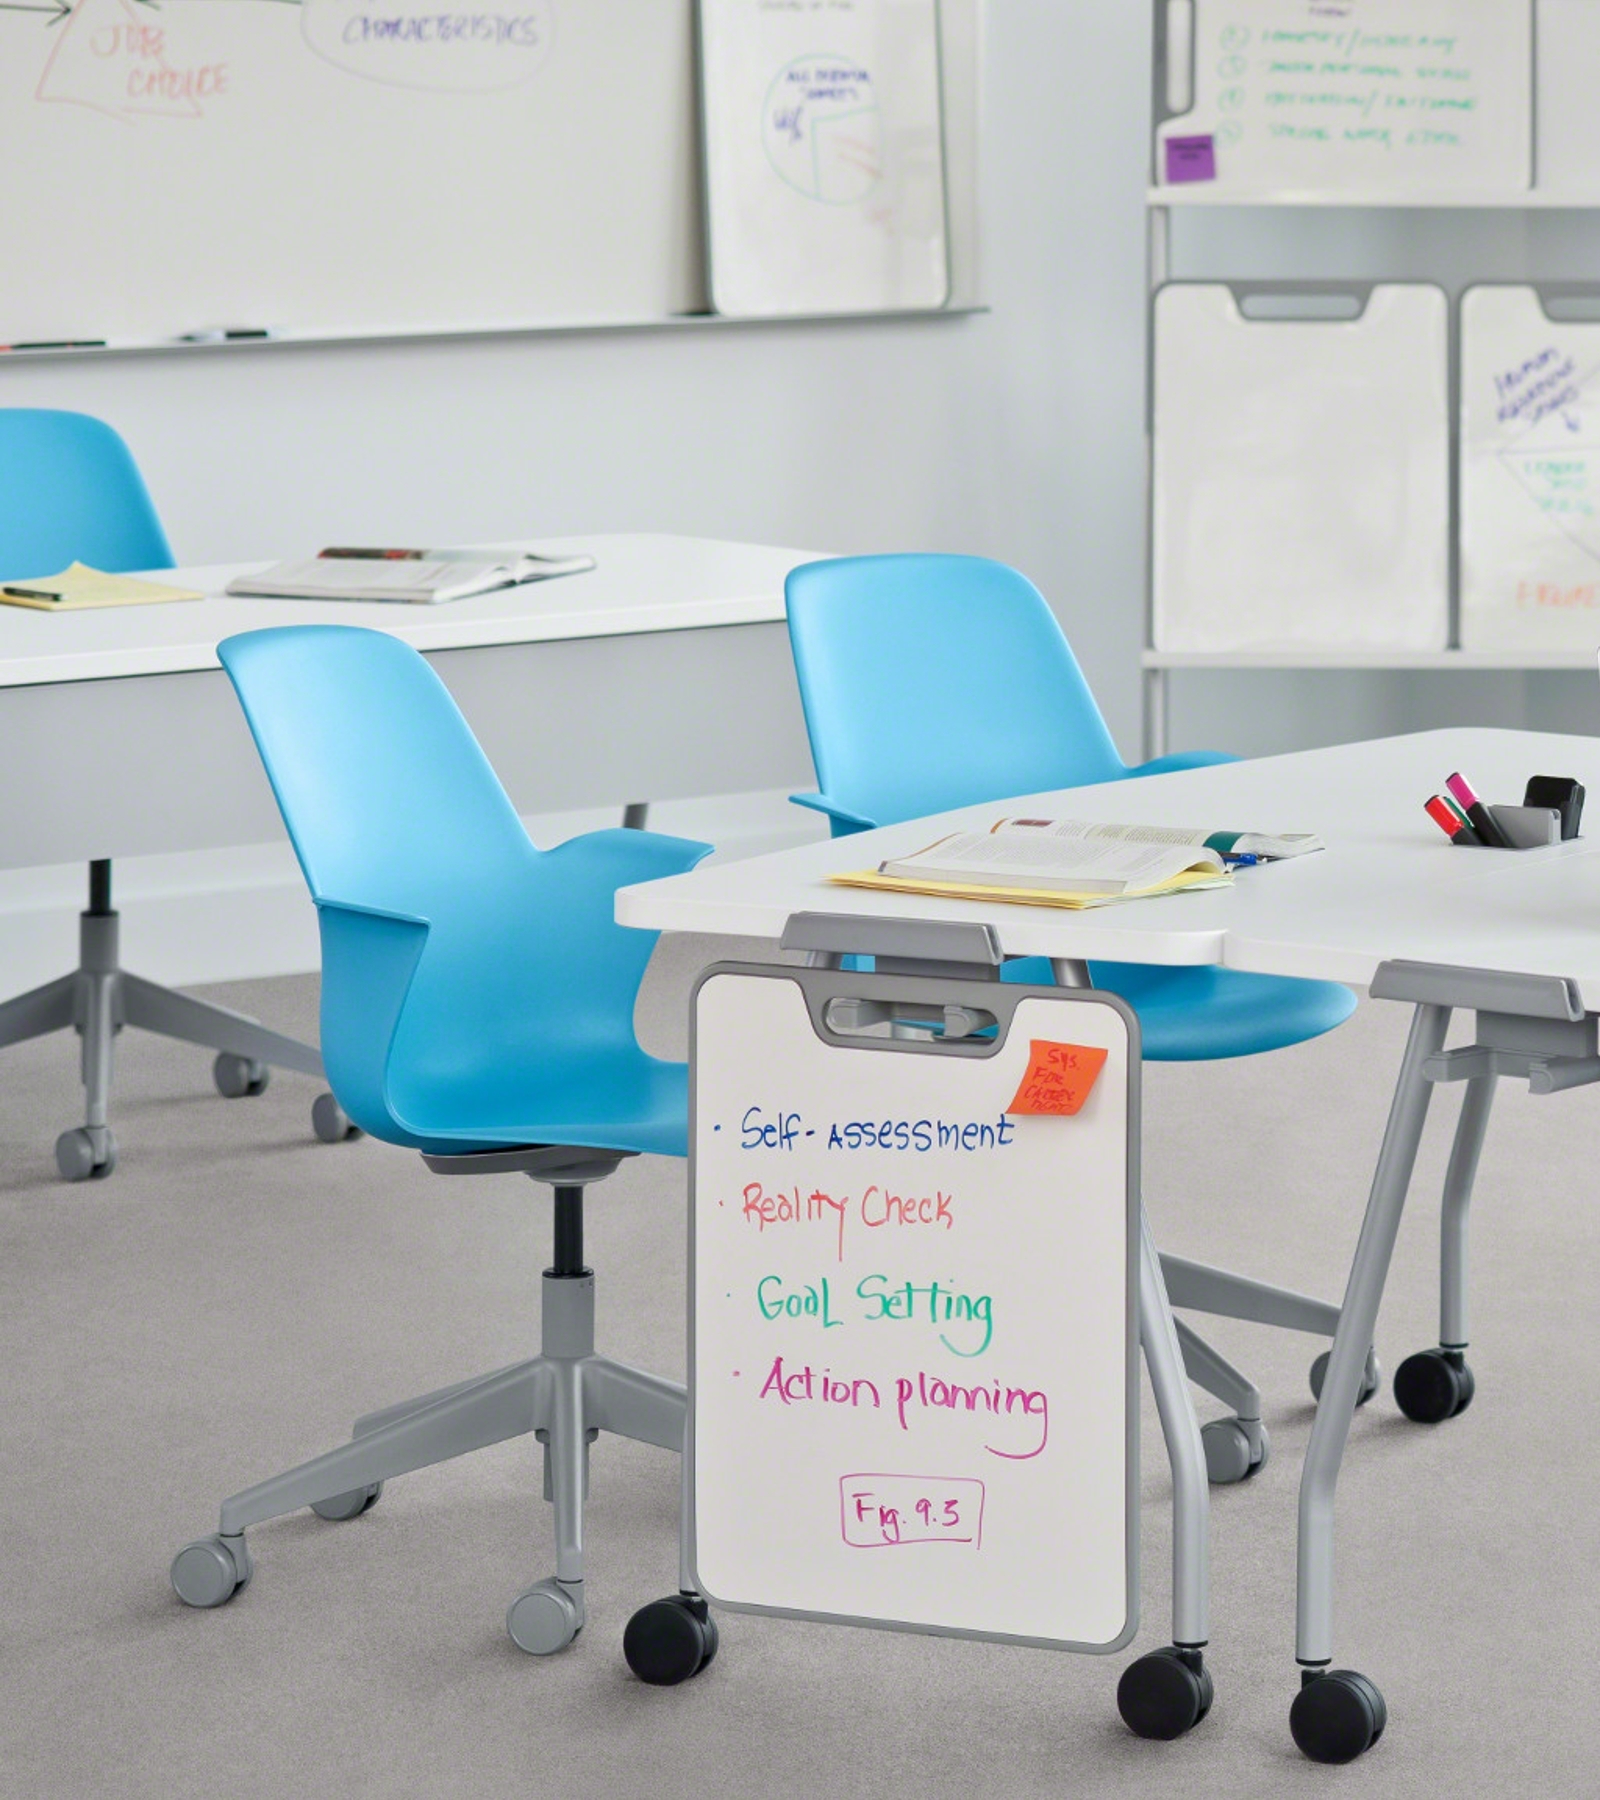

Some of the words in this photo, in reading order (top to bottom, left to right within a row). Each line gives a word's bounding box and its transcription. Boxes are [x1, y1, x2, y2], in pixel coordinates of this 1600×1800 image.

[861, 1185, 954, 1230] Check
[857, 1274, 994, 1358] Setting
[760, 1356, 881, 1408] Action
[896, 1371, 1049, 1460] planning
[851, 1492, 907, 1545] Fig.
[915, 1497, 961, 1528] 9.3
